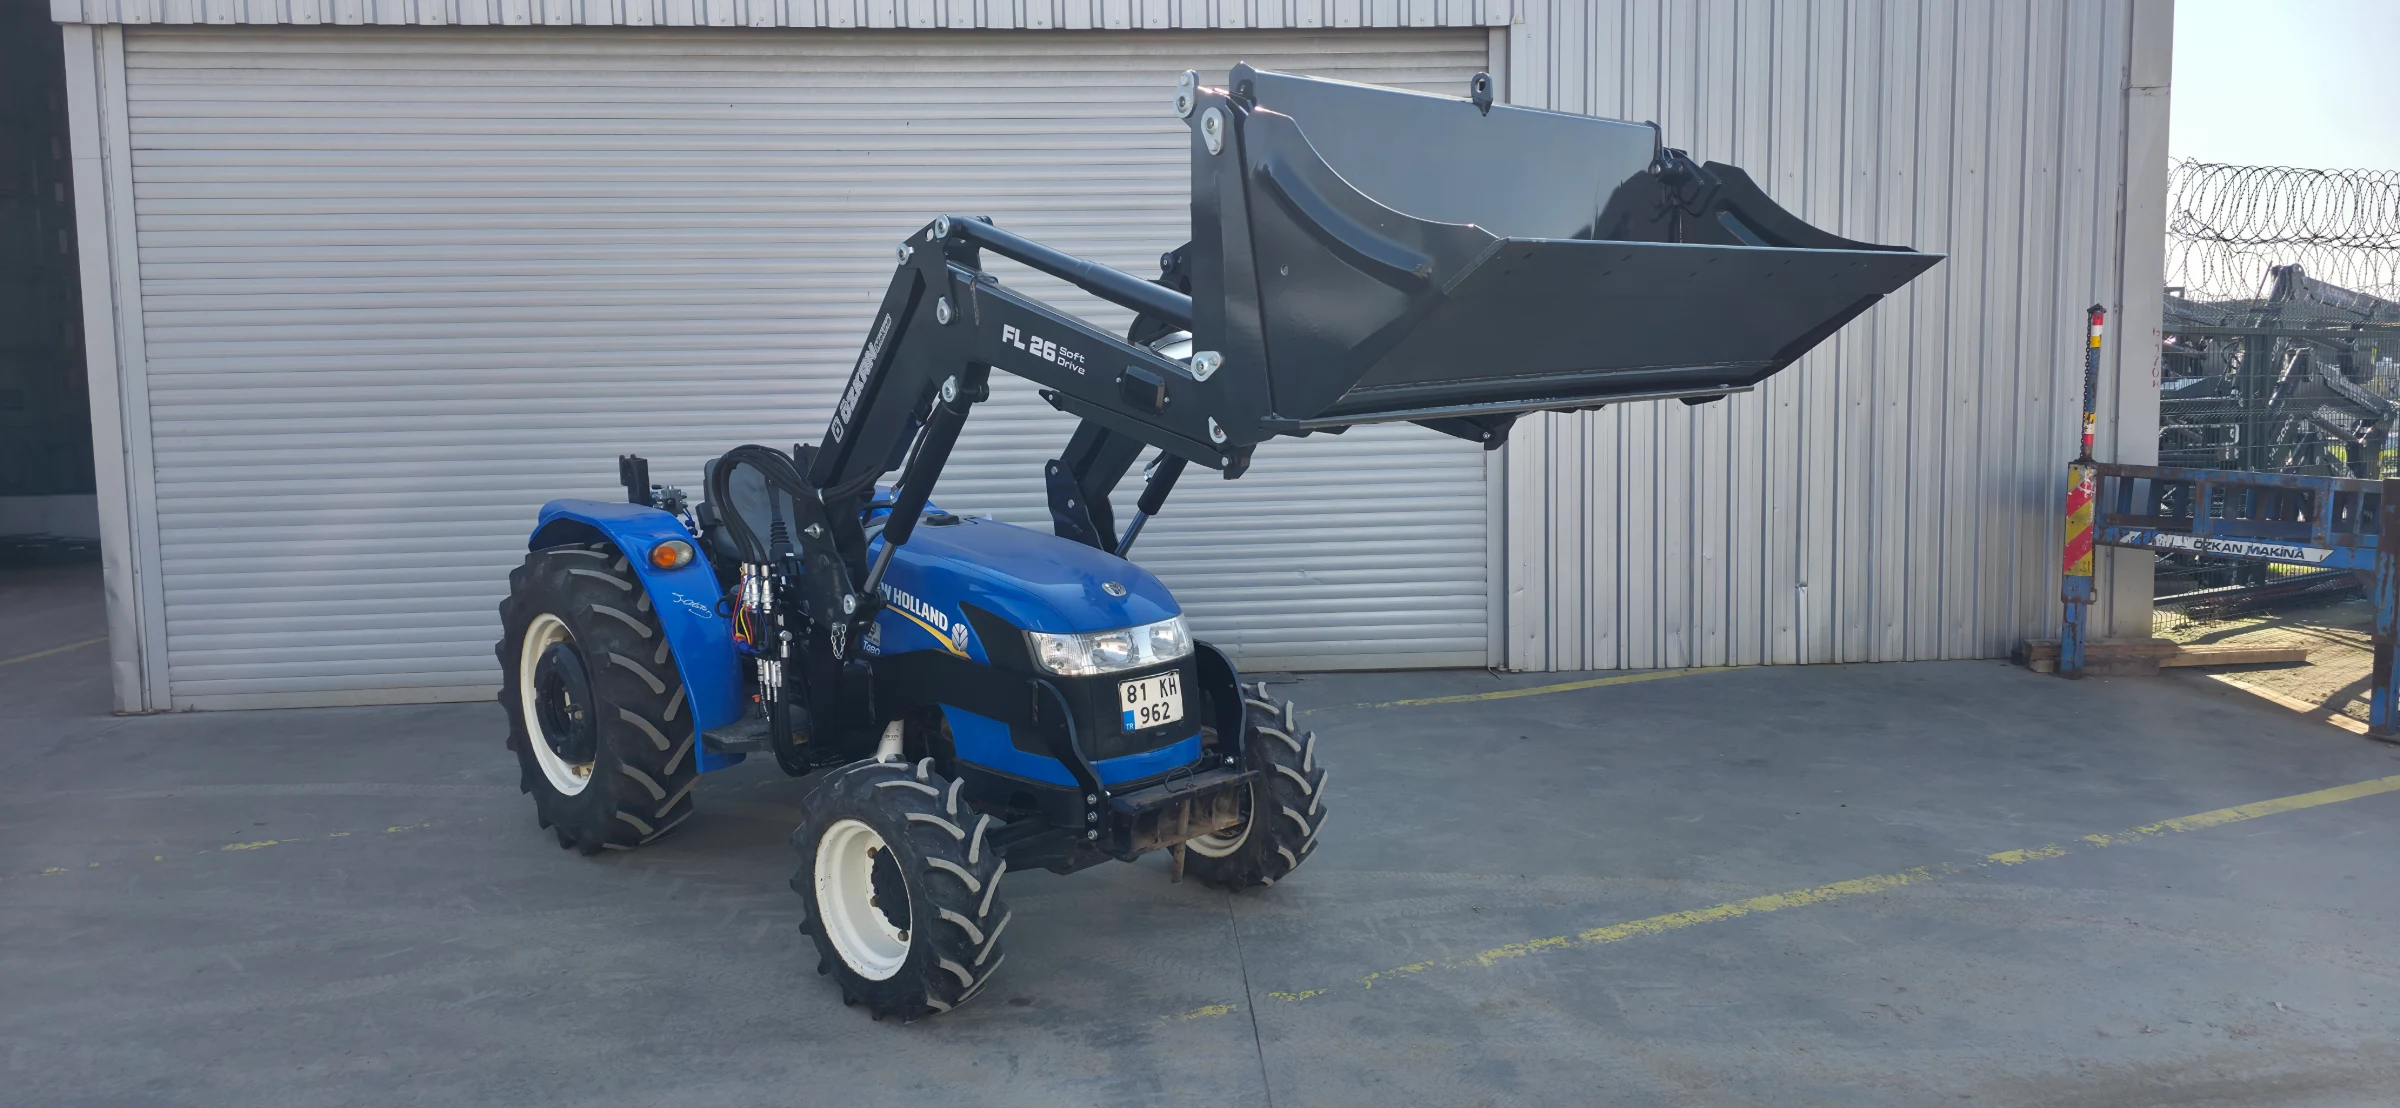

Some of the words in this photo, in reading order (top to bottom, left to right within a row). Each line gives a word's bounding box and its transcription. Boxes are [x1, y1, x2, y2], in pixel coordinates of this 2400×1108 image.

[1002, 323, 1026, 351] FL
[1029, 335, 1057, 362] 26
[1057, 356, 1086, 375] Drive
[1059, 346, 1086, 364] Soft
[2193, 538, 2243, 554] ÖZKAN
[893, 587, 949, 632] HOLLAND
[1127, 682, 1147, 704] 81
[1159, 677, 1178, 698] KH
[1140, 701, 1171, 725] 962
